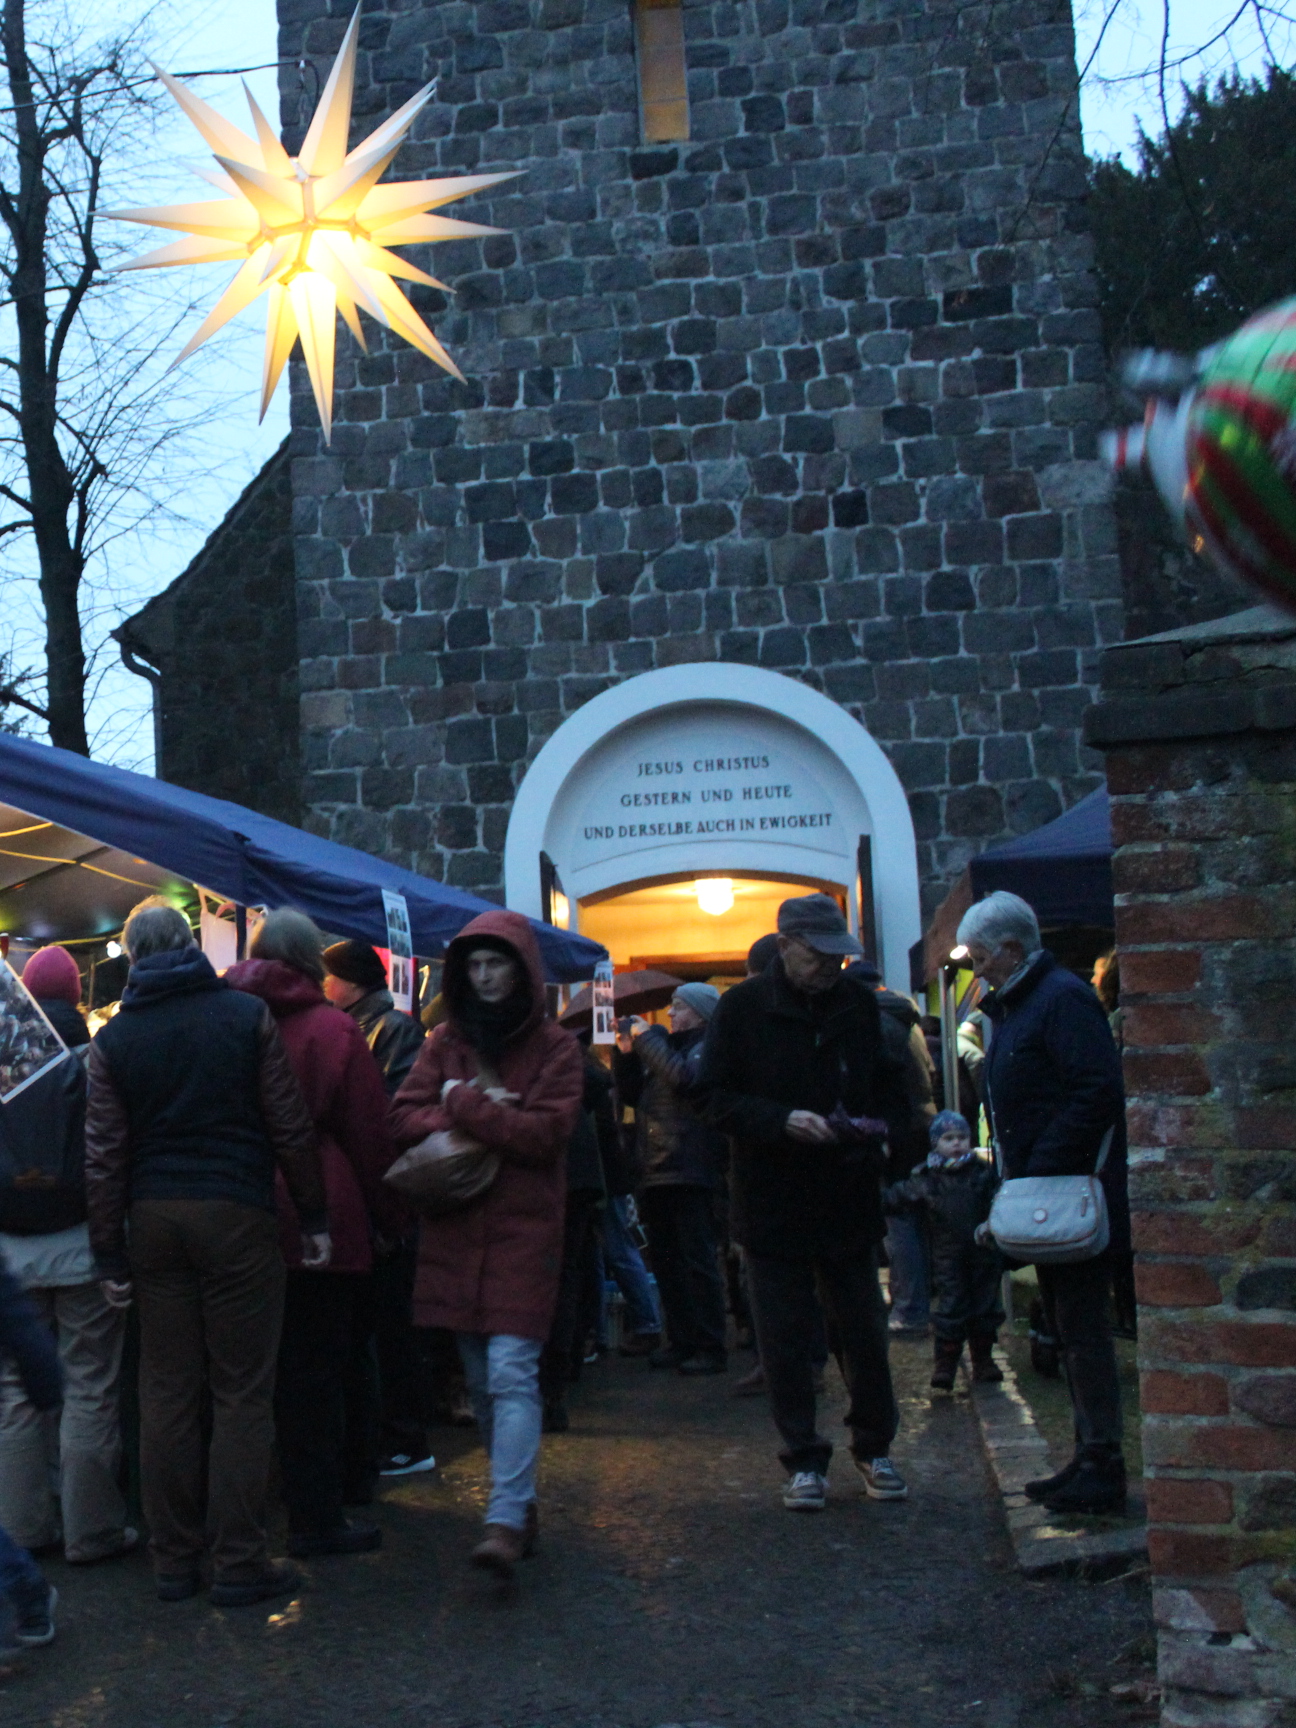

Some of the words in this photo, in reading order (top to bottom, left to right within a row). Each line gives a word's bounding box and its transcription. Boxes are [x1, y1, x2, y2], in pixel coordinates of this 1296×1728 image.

[637, 761, 683, 777] JESUS
[693, 756, 770, 773] CHRISTUS
[620, 791, 691, 807] GESTERN
[701, 789, 733, 802] UND
[742, 785, 792, 800] HEUTE
[584, 825, 614, 840] UND
[618, 821, 693, 838] DERSELBE
[696, 818, 735, 834] AUCH
[740, 816, 755, 831] IN
[760, 813, 833, 830] EWIGKEIT
